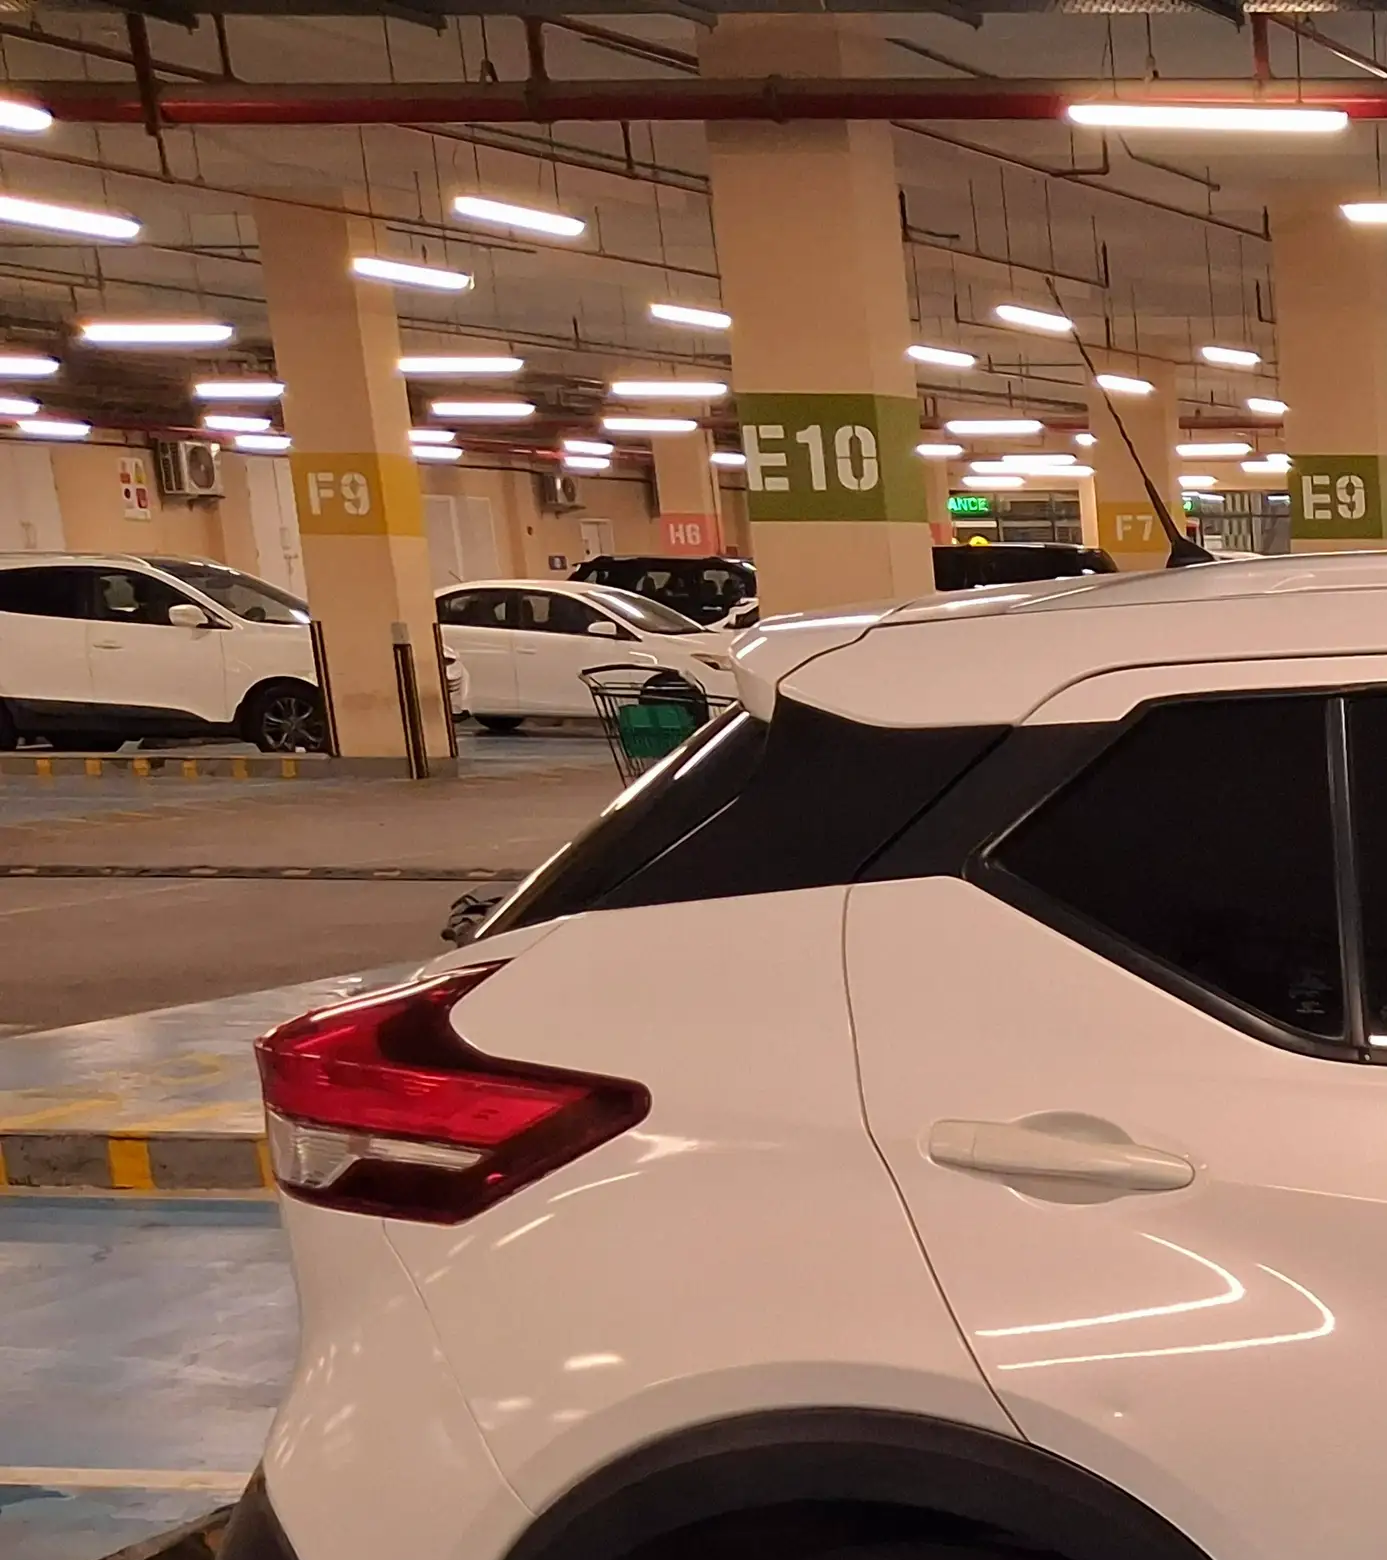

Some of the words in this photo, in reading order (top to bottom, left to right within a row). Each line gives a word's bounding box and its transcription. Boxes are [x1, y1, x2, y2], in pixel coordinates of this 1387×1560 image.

[742, 424, 879, 491] E10
[307, 472, 370, 515] F9
[1302, 475, 1366, 519] E9
[1116, 514, 1153, 541] F7
